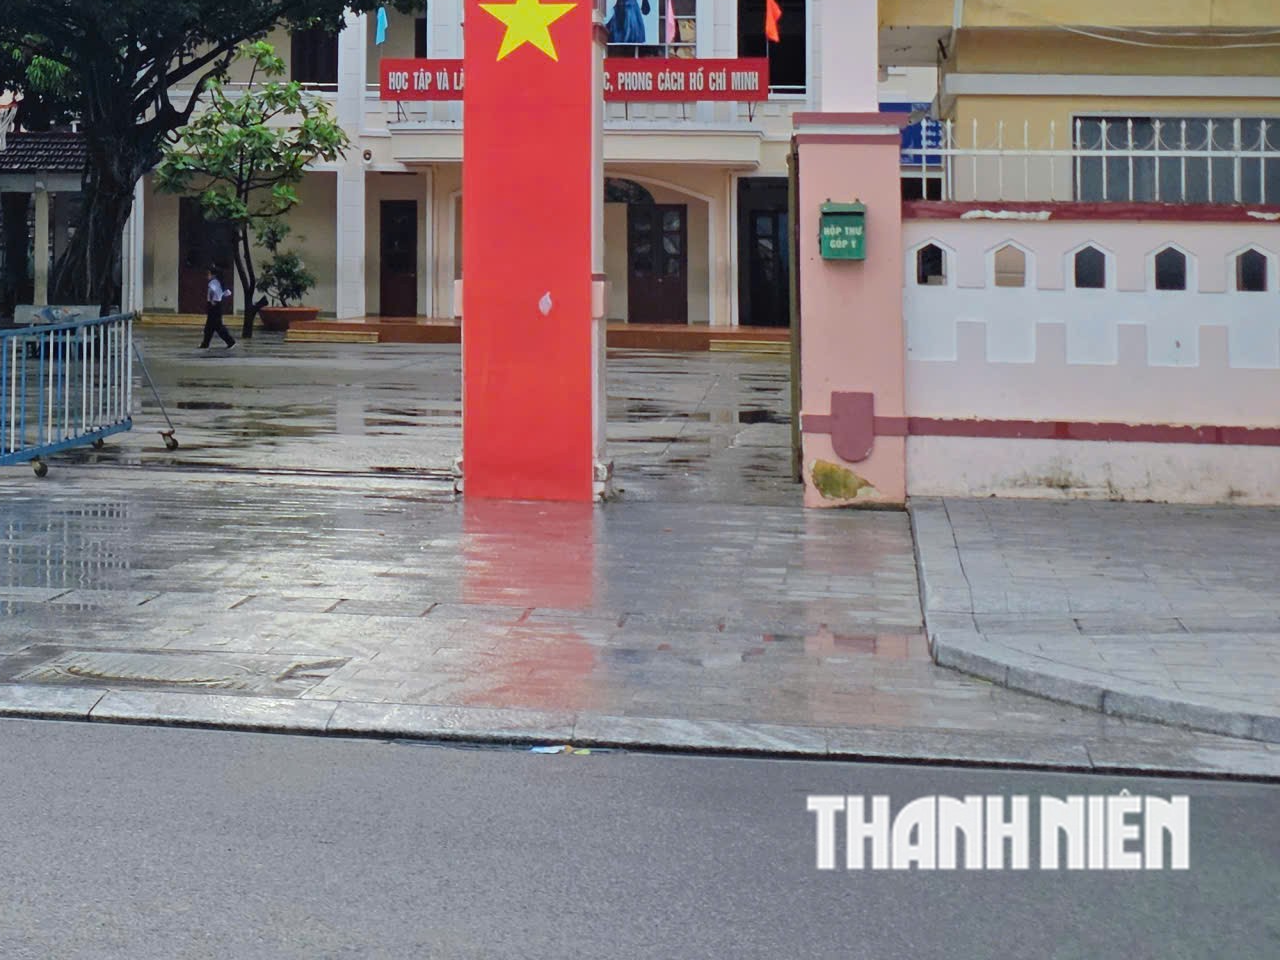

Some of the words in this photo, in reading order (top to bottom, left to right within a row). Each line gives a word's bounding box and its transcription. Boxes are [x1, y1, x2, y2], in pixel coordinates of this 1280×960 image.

[388, 71, 409, 94] HỌC
[413, 68, 432, 92] TẬP
[436, 67, 449, 91] VÀ
[618, 71, 653, 91] PHONG
[657, 68, 685, 91] CÁCH
[708, 68, 726, 91] CHÍ
[731, 71, 759, 91] MINH
